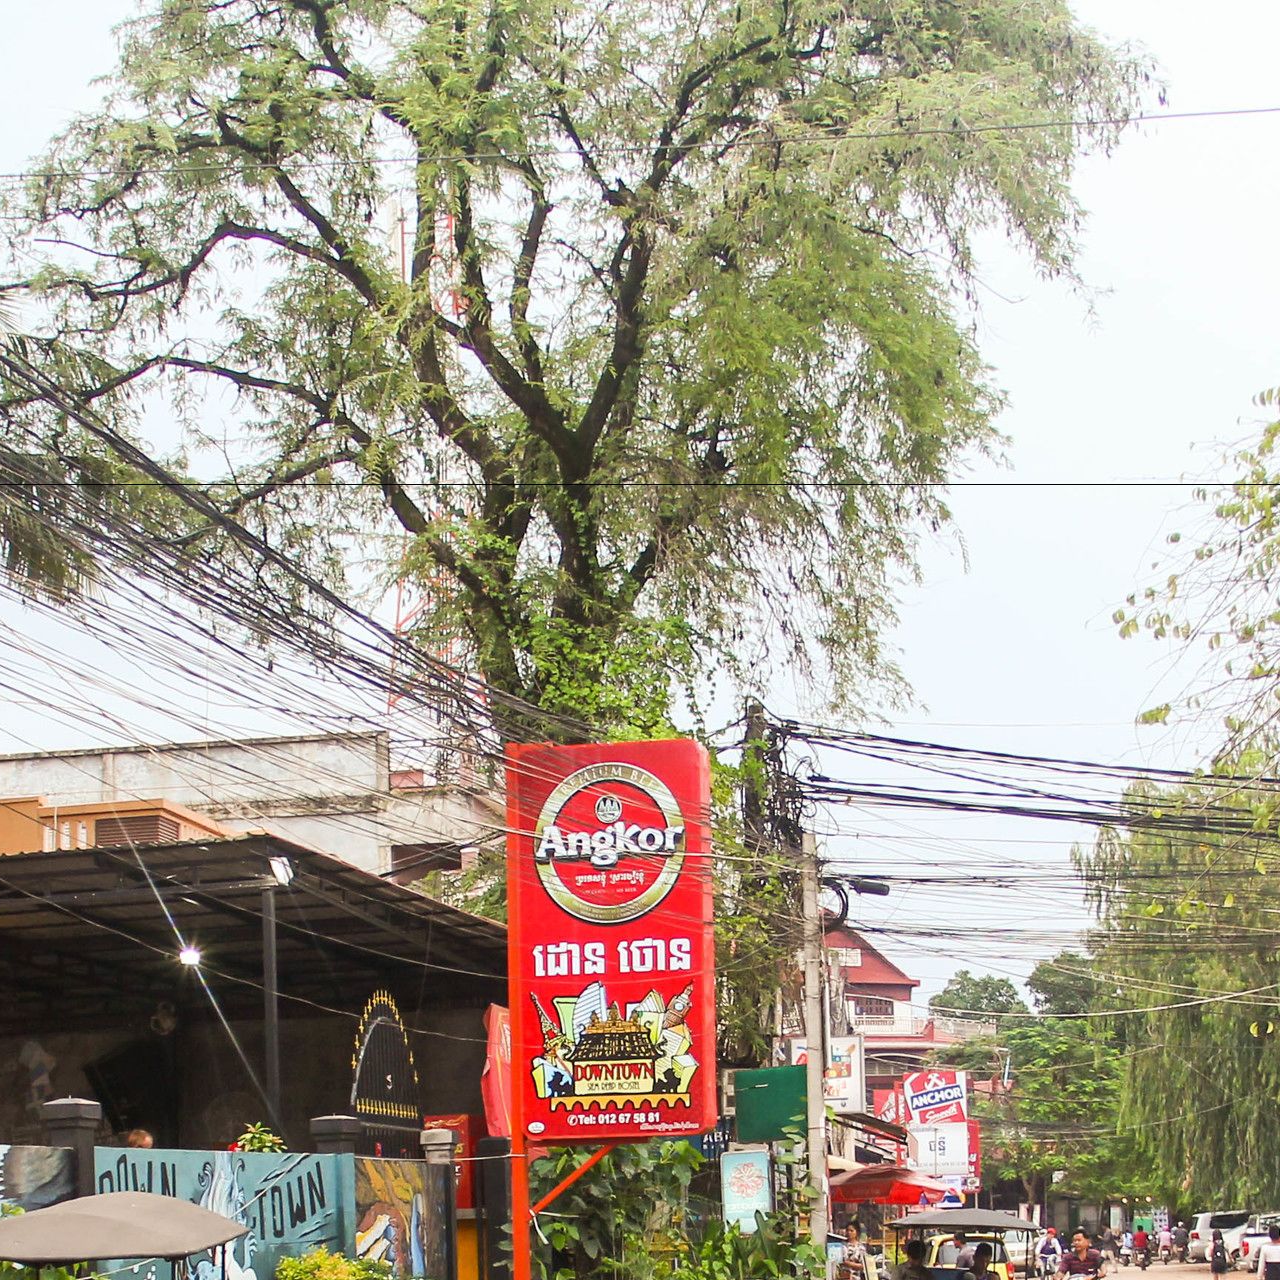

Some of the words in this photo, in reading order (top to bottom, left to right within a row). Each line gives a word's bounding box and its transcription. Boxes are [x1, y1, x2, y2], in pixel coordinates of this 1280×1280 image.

[536, 820, 685, 866] Angkor
[575, 1062, 655, 1082] DOWNTOWN
[618, 1081, 640, 1090] HOSTEL
[912, 1087, 962, 1109] ANCHOR
[578, 1114, 596, 1124] Tel:
[598, 1114, 616, 1124] 012
[619, 1113, 632, 1124] 67
[633, 1112, 646, 1123] 58
[647, 1112, 660, 1123] 81
[253, 1161, 326, 1241] TOWN
